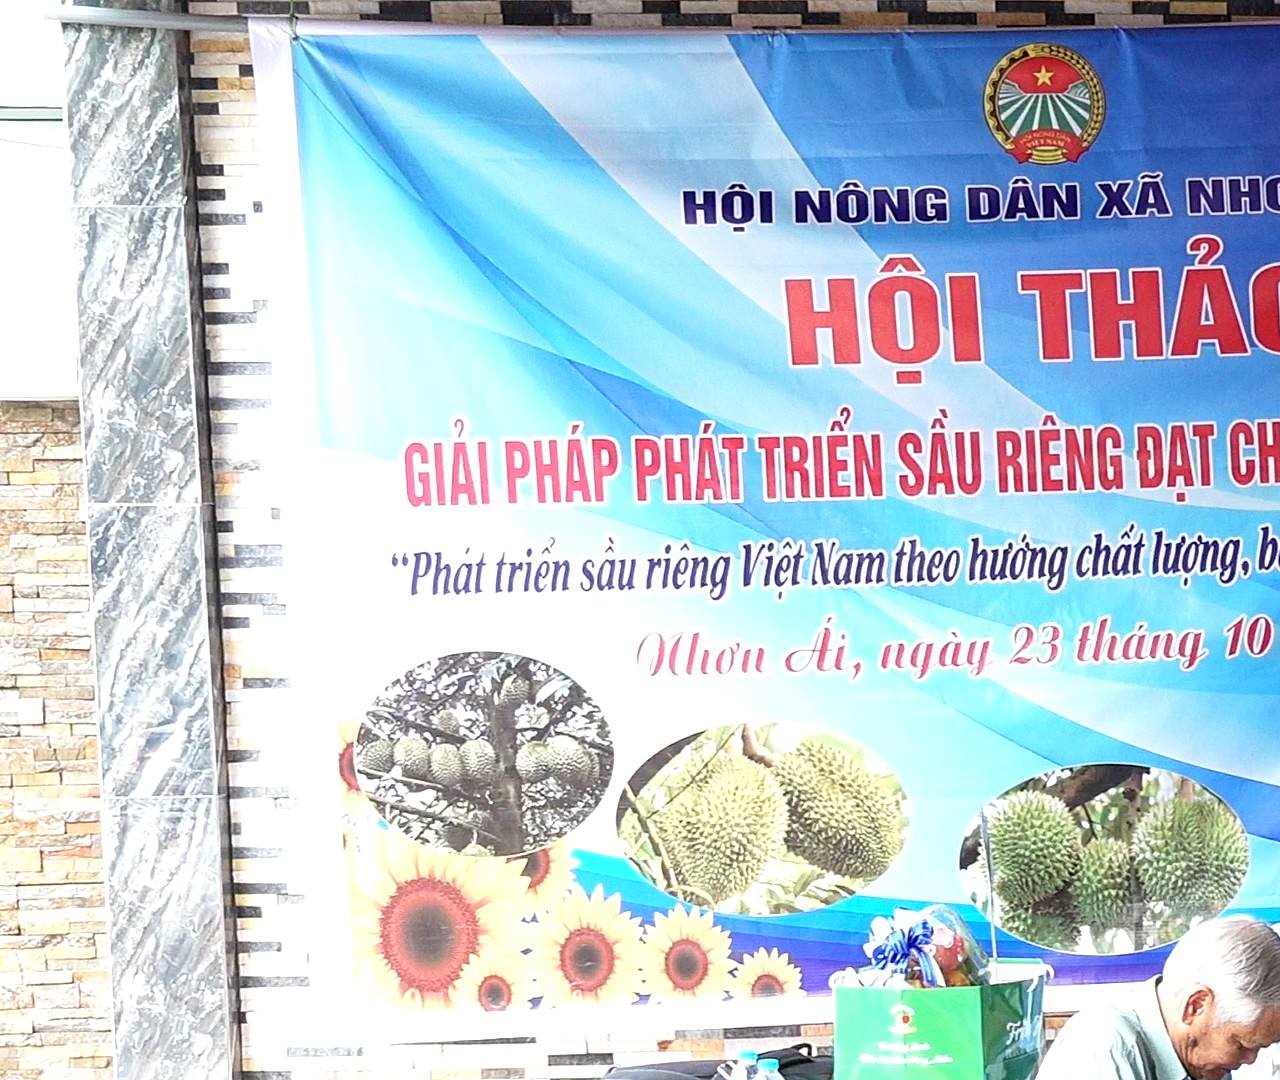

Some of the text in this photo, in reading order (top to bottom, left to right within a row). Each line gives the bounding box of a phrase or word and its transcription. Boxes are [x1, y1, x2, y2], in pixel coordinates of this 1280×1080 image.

[682, 183, 774, 233] HỘI
[795, 180, 947, 224] NÔNG
[967, 176, 1079, 222] DÂN
[1095, 173, 1170, 218] XÃ
[786, 255, 982, 383] HỘI
[404, 418, 491, 507] GIẢI
[506, 425, 619, 505] PHÁP
[632, 423, 745, 502] PHÁT
[757, 407, 883, 500] TRIỂN
[898, 409, 981, 498] SẦU
[998, 412, 1123, 493] RIÊNG
[1136, 424, 1216, 502] ĐẠT
[496, 536, 570, 593] triển
[581, 537, 638, 590] sầu
[647, 543, 729, 600] riêng
[742, 540, 803, 599] Việt
[811, 540, 886, 585] Nam
[895, 540, 958, 582] theo
[967, 533, 1068, 590] hướng
[1077, 523, 1145, 577] chất
[1153, 530, 1250, 586] lượng,
[637, 630, 768, 677] Nhơn
[786, 618, 860, 679] Ái,
[880, 631, 992, 677] ngày
[1010, 625, 1058, 665] 23
[1077, 616, 1208, 668] tháng
[1225, 615, 1272, 655] 10
